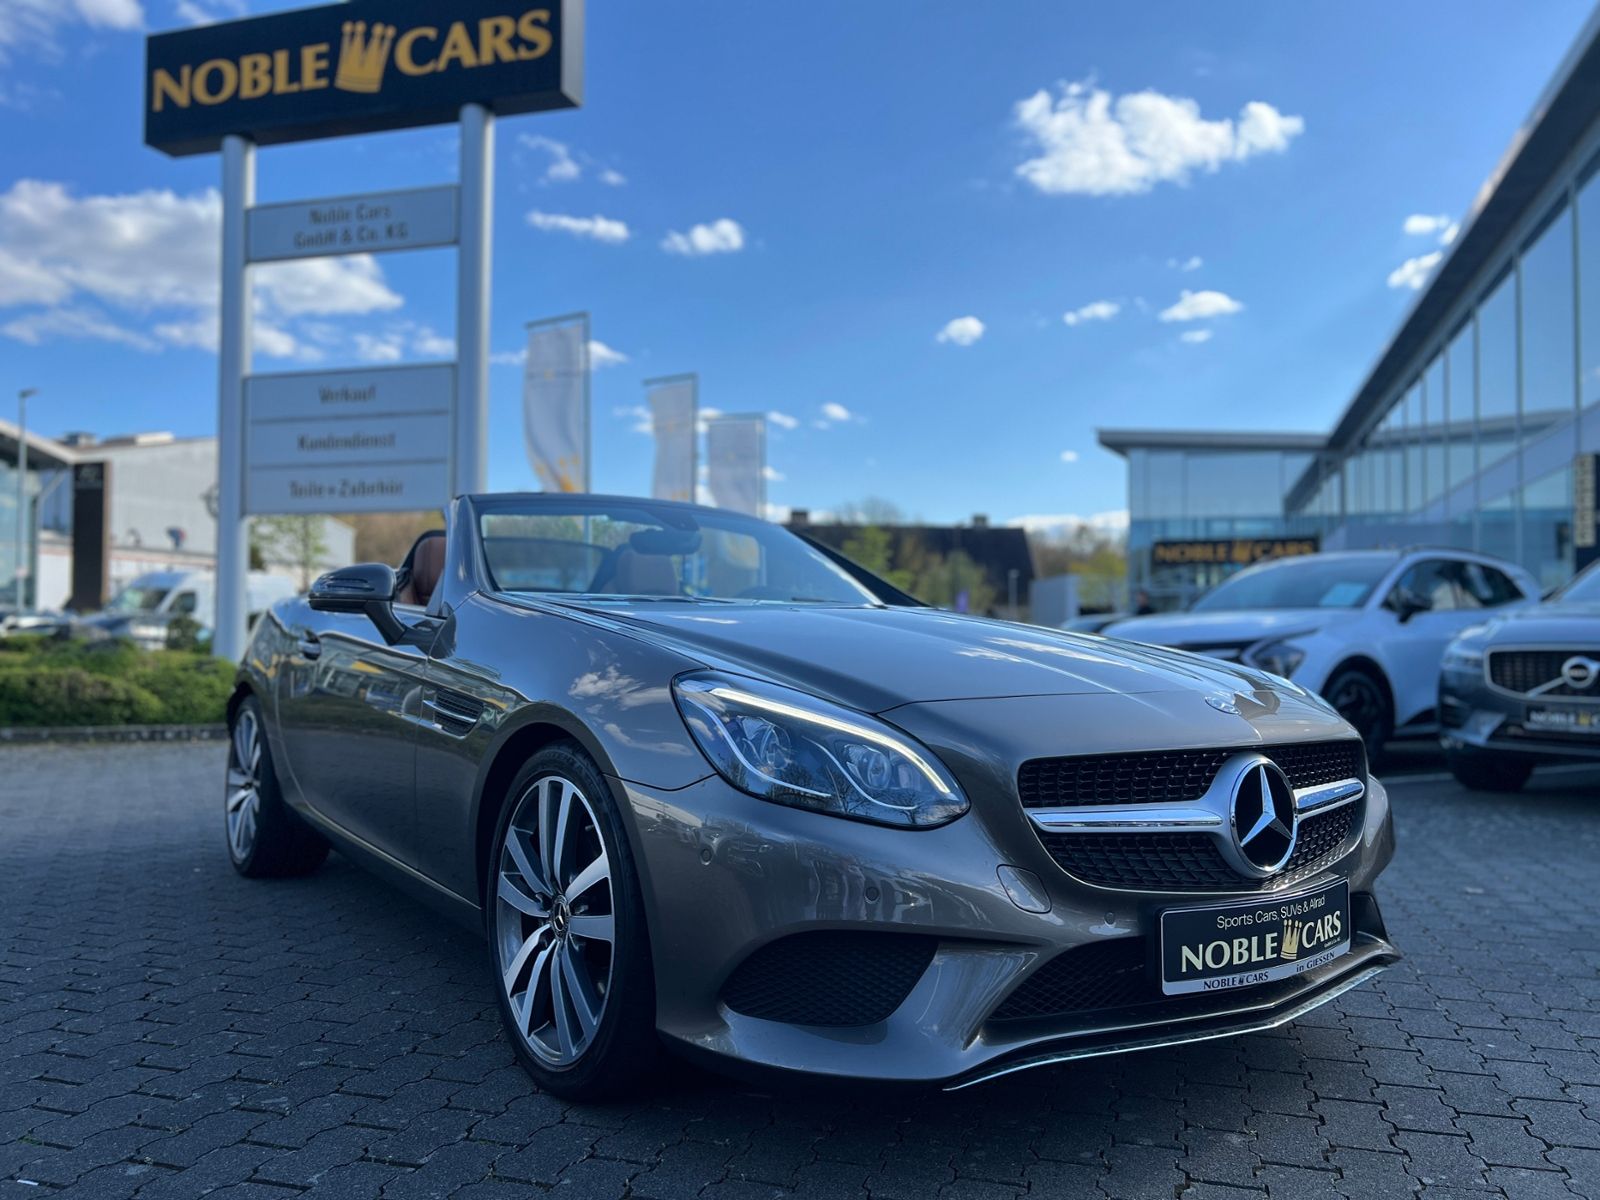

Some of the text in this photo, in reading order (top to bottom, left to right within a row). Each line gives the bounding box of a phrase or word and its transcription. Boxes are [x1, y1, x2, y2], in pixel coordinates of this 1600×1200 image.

[152, 9, 553, 112] NOBLE CARS
[319, 385, 376, 404] Verkauf
[297, 432, 396, 451] Kundendienst
[1154, 542, 1227, 563] NOBLE
[1216, 915, 1254, 931] Sports
[1280, 903, 1302, 919] SUVs
[1302, 901, 1309, 913] &
[1309, 894, 1326, 910] Allrad
[1180, 910, 1341, 972] NOBLE CARS
[1296, 951, 1335, 973] in GIESSEN
[1203, 971, 1269, 990] NOBLE CARS
